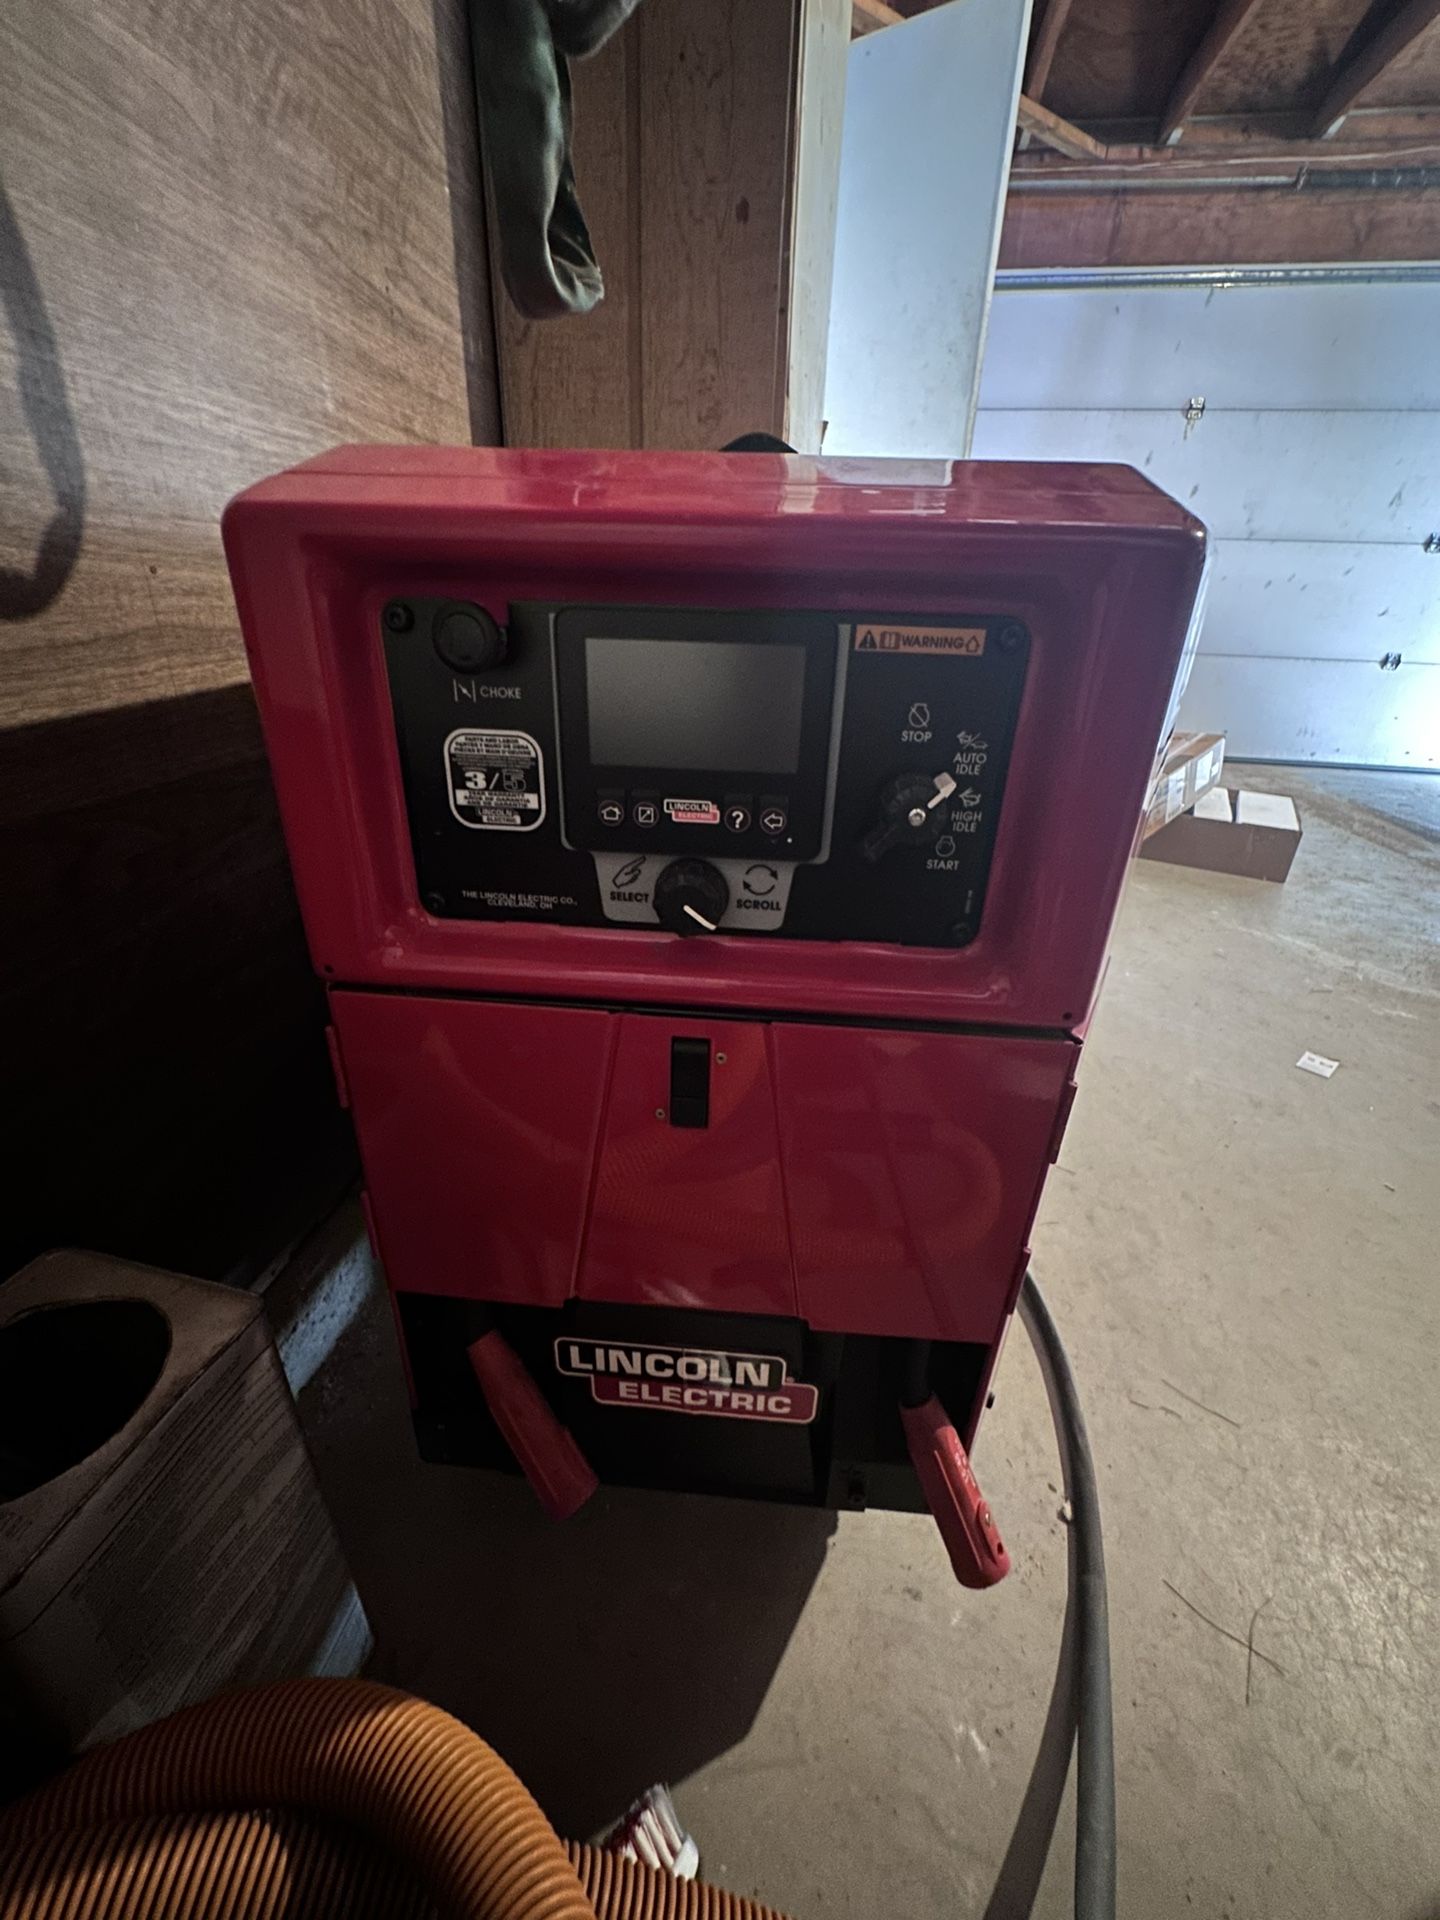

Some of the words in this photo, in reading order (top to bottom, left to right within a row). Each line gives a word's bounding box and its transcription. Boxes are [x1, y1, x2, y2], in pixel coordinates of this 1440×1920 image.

[901, 633, 964, 650] WARNING
[480, 687, 522, 699] CHOKE
[901, 731, 932, 742] STOP
[953, 753, 987, 764] AUTO
[955, 763, 981, 776] IDLE
[668, 802, 710, 811] LINCOLN
[951, 811, 982, 823] HIGH
[952, 821, 977, 833] IDLE
[926, 859, 959, 871] START
[461, 890, 477, 899] THE
[479, 891, 516, 900] LINCOLN
[518, 893, 558, 904] ELECTRIC
[610, 891, 649, 904] SELECT
[539, 902, 553, 910] OH
[736, 899, 781, 912] SCROLL
[569, 1345, 770, 1388] LINCOLN
[618, 1381, 792, 1415] ELECTRIC
